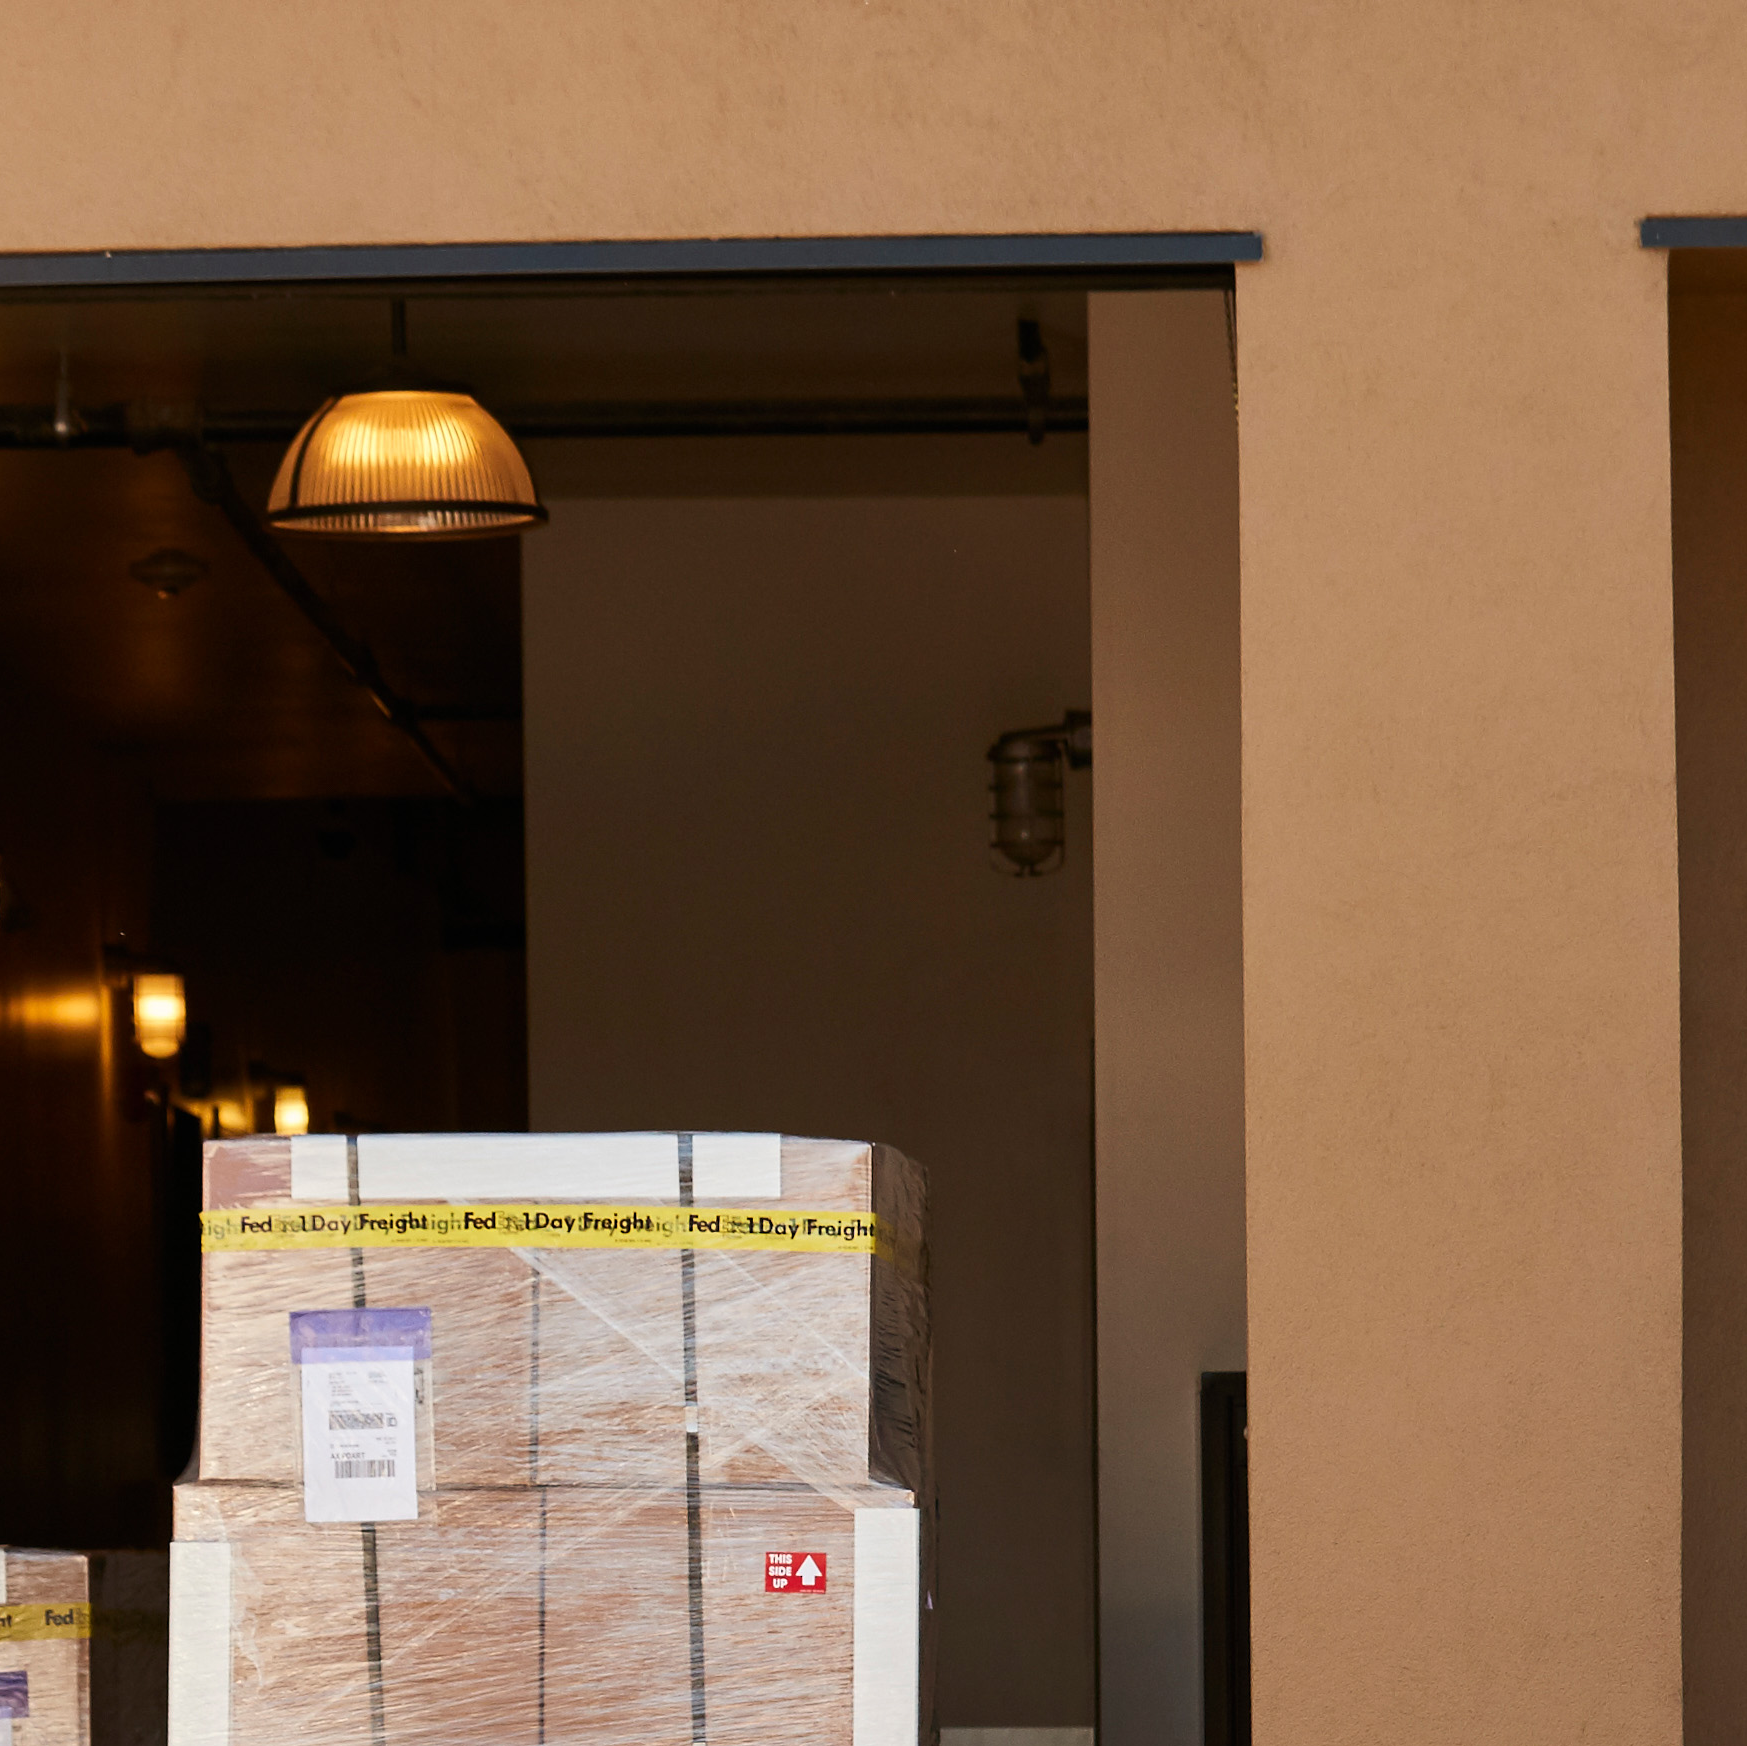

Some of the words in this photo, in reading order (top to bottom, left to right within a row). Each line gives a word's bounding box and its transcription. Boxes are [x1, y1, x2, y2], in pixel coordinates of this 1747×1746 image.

[359, 1211, 428, 1234] Freight
[582, 1211, 652, 1234] Freight
[746, 1217, 799, 1240] 1Day
[806, 1217, 875, 1241] Freight
[767, 1553, 793, 1565] THIS
[767, 1565, 792, 1577] SIDE
[772, 1578, 789, 1589] UP
